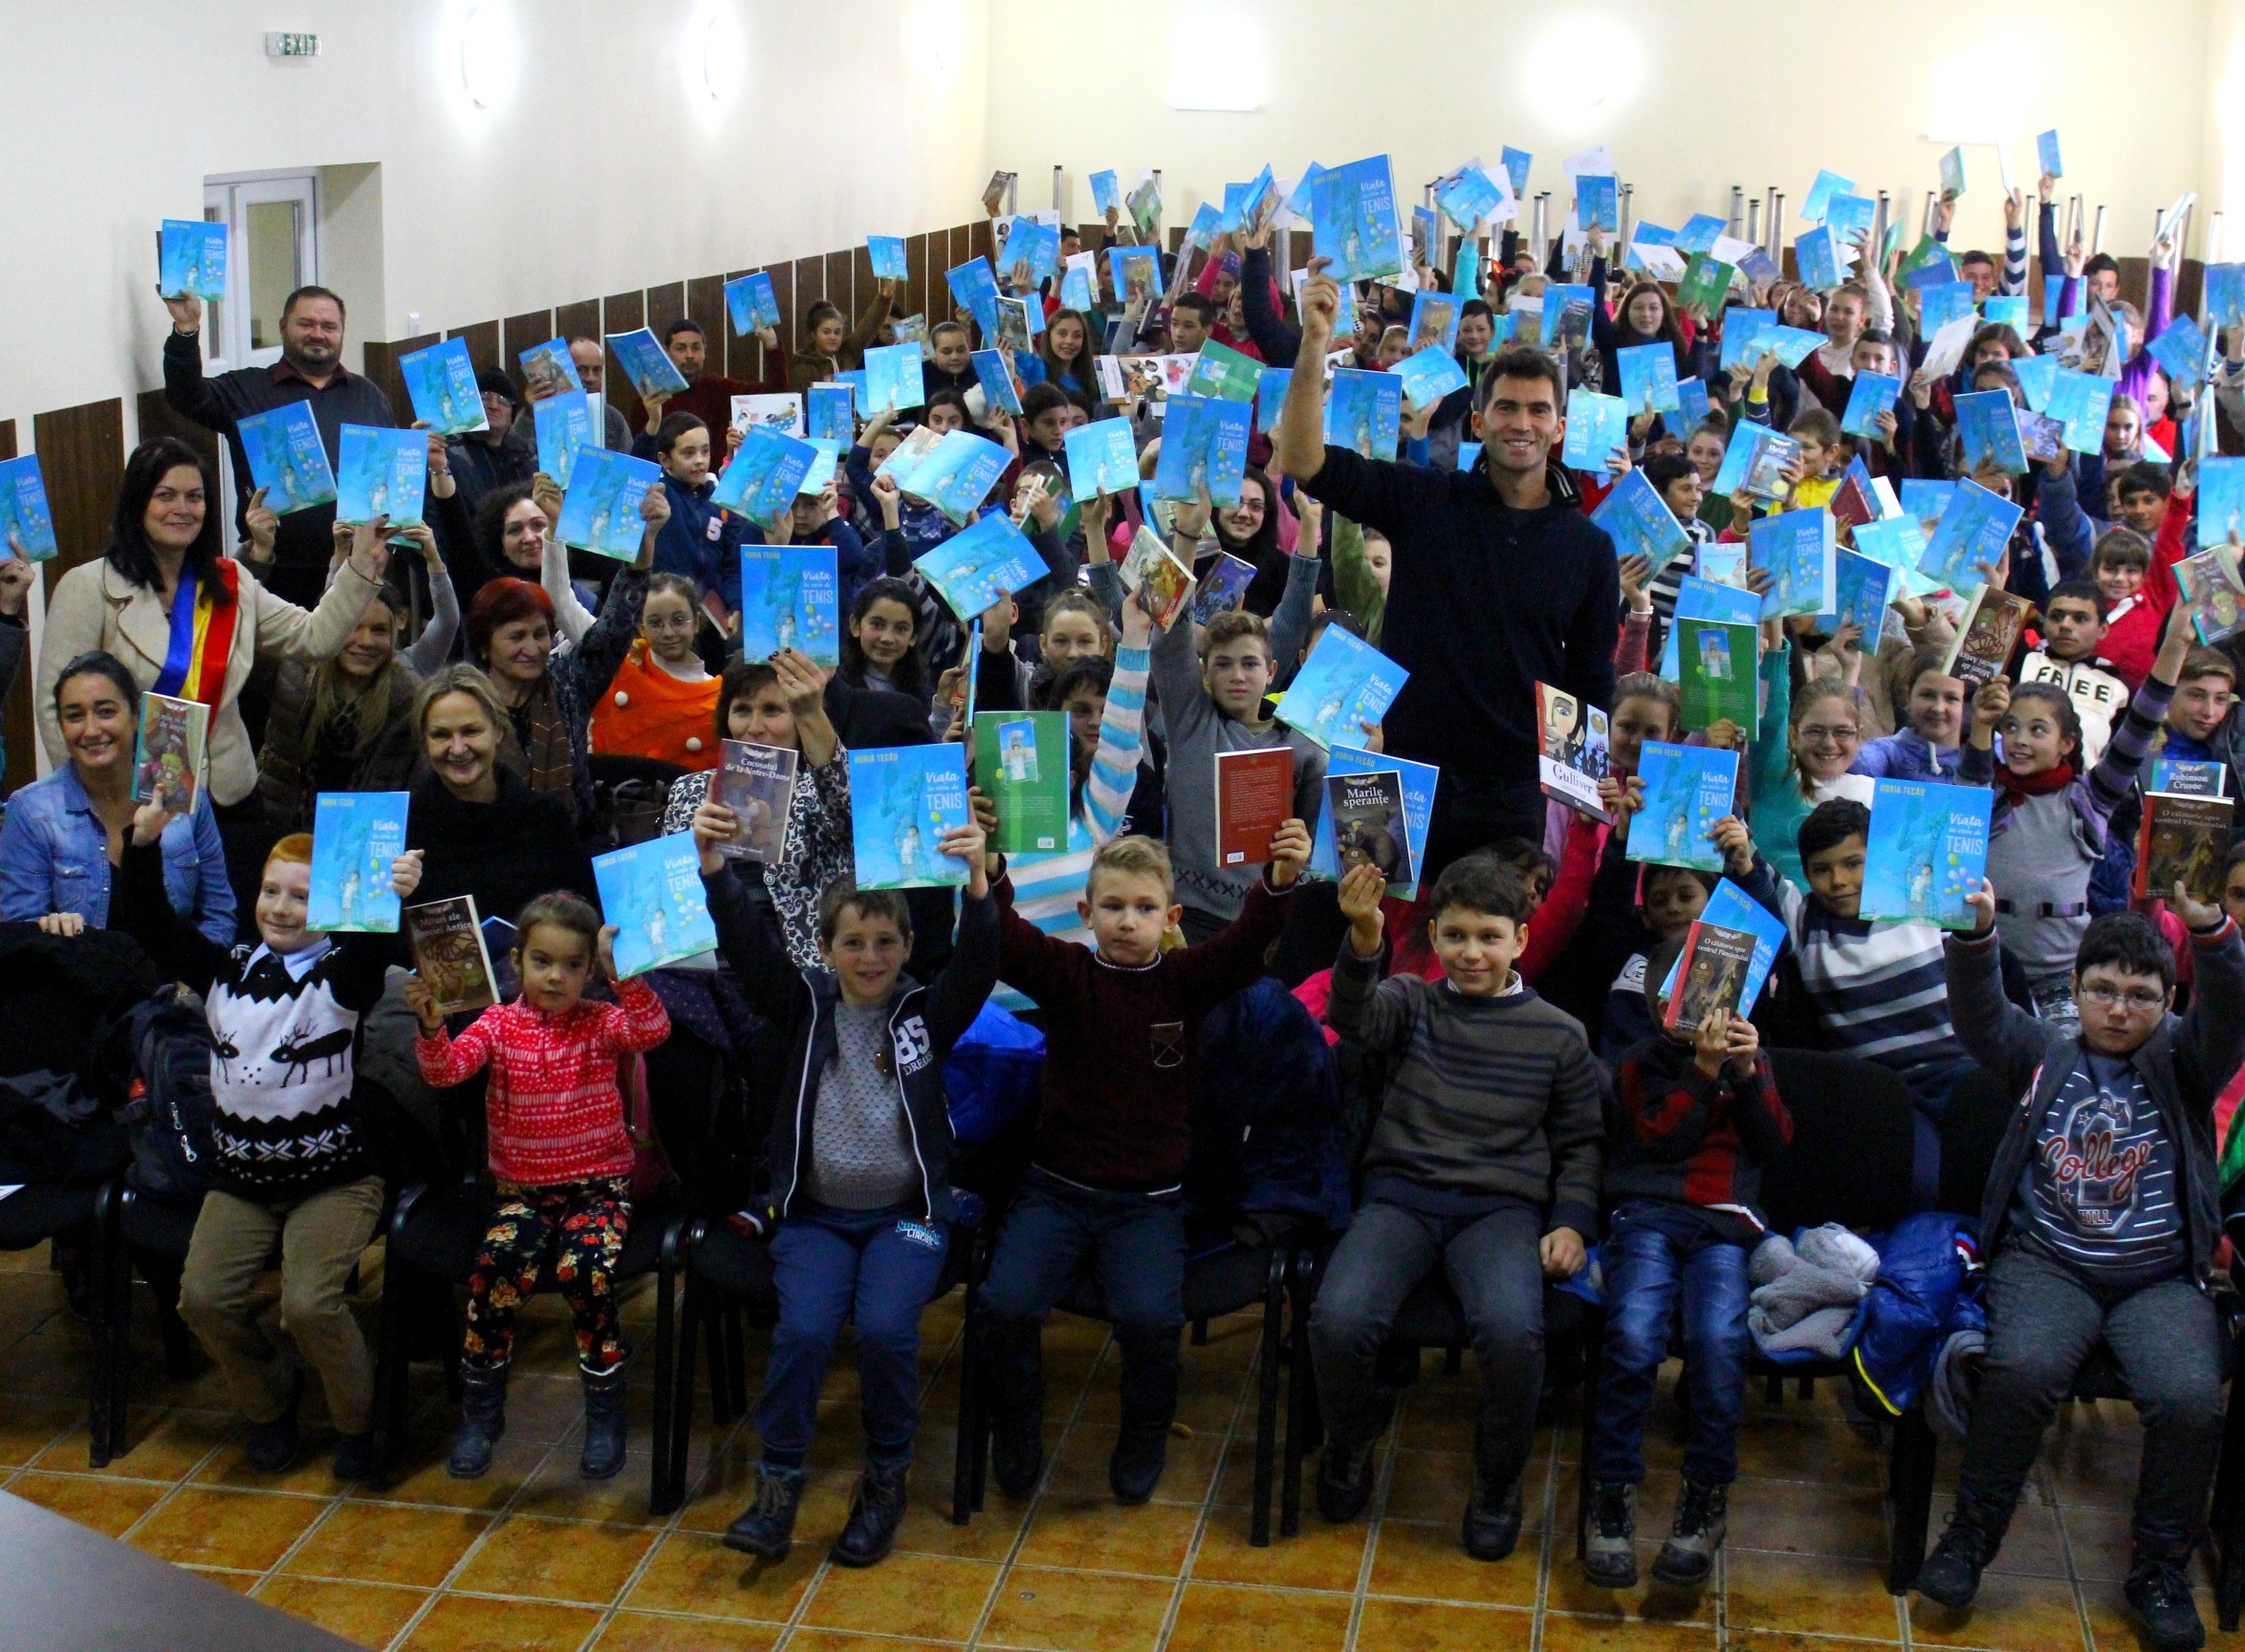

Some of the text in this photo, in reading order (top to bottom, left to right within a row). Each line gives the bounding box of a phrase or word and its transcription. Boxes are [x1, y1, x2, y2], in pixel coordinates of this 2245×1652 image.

[283, 33, 316, 55] EXIT
[1362, 197, 1390, 214] TENIS
[1376, 402, 1397, 416] TENIS
[291, 436, 316, 451] TENIS
[1217, 437, 1244, 452] TENIS
[1769, 444, 1788, 455] Heidi
[776, 467, 800, 487] TENIS
[623, 491, 643, 507] TEN
[707, 516, 724, 542] 5
[1797, 541, 1821, 556] TENIS
[993, 564, 1017, 591] TENIS
[803, 589, 832, 604] TENIS
[2036, 666, 2110, 704] FREE
[1358, 687, 1386, 714] TENIS
[744, 767, 792, 781] Notre-Dame
[1553, 764, 1593, 793] Gulliver
[2169, 772, 2209, 783] Robinson
[1347, 787, 1384, 799] Marile
[2172, 780, 2203, 790] Crusoe
[926, 793, 963, 810] TENIS
[1343, 794, 1390, 810] speranțe
[1699, 791, 1729, 807] TENIS
[1406, 811, 1426, 830] NIS
[370, 841, 400, 859] TENIS
[1947, 836, 1984, 856] TENIS
[667, 872, 702, 890] TENIS
[420, 912, 461, 927] Mituri ale
[446, 921, 472, 932] Antice
[1697, 945, 1717, 954] centrul
[1749, 958, 1767, 982] ENIS
[895, 1014, 930, 1065] 85
[2043, 1130, 2151, 1203] College
